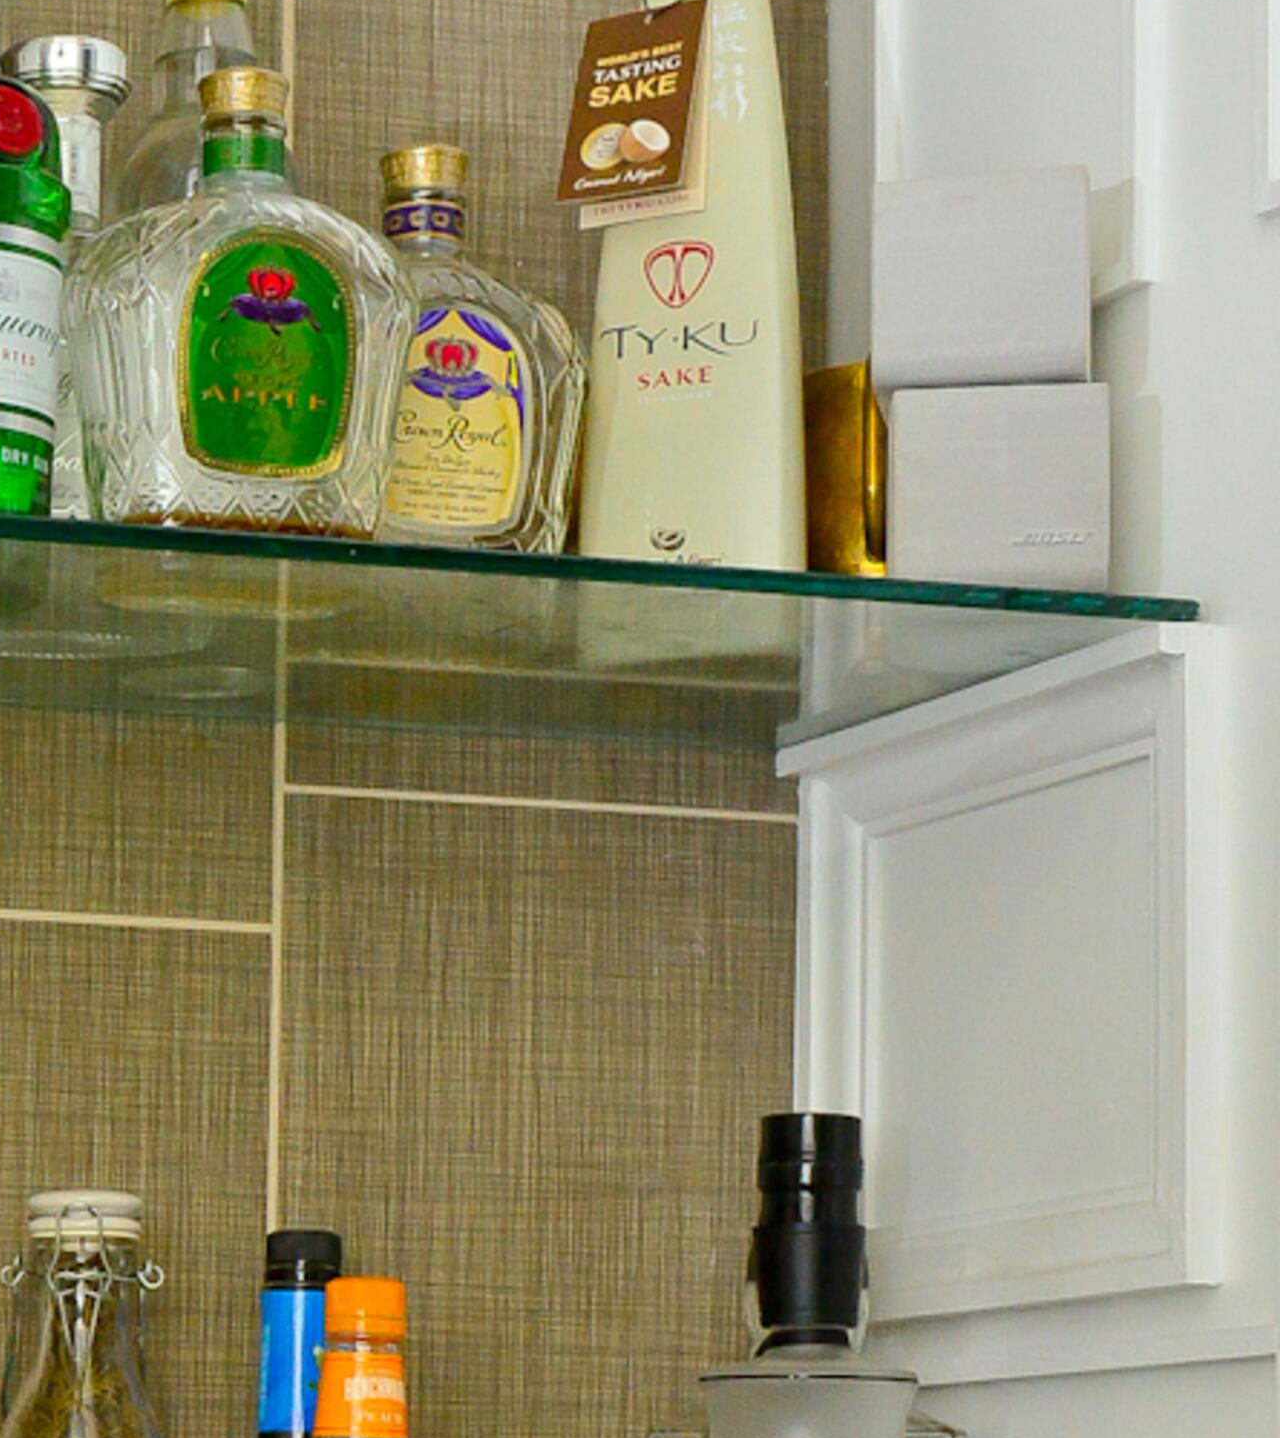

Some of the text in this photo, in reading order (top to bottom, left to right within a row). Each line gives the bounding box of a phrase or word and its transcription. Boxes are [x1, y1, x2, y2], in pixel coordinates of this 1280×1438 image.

[593, 55, 682, 85] TASTING
[588, 72, 680, 108] SAKE
[637, 364, 714, 393] SAKE
[201, 383, 328, 412] APPLE
